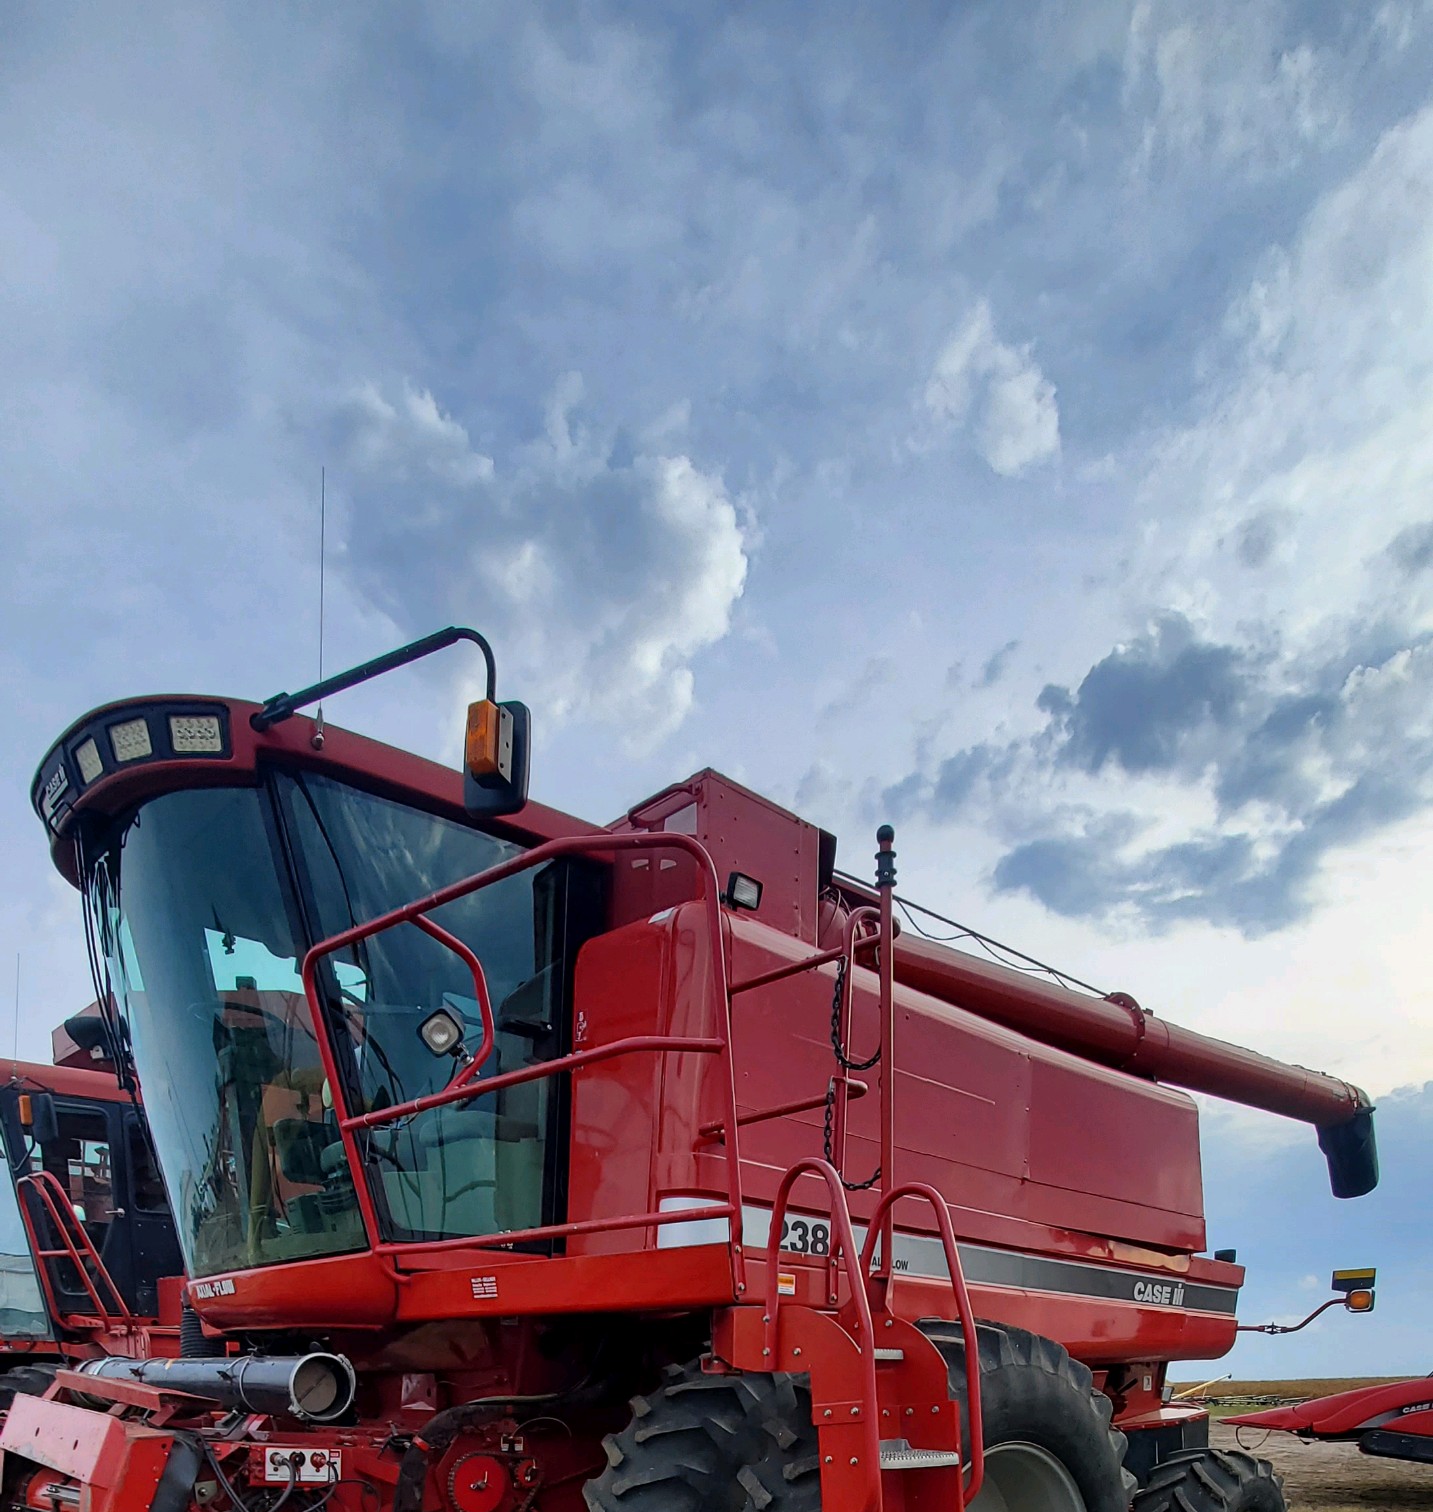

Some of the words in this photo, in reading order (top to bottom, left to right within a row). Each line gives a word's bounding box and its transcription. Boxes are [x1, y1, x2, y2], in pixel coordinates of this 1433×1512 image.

[45, 772, 61, 800] CASE
[1133, 1281, 1172, 1304] CASE
[1402, 1403, 1430, 1413] CASE
